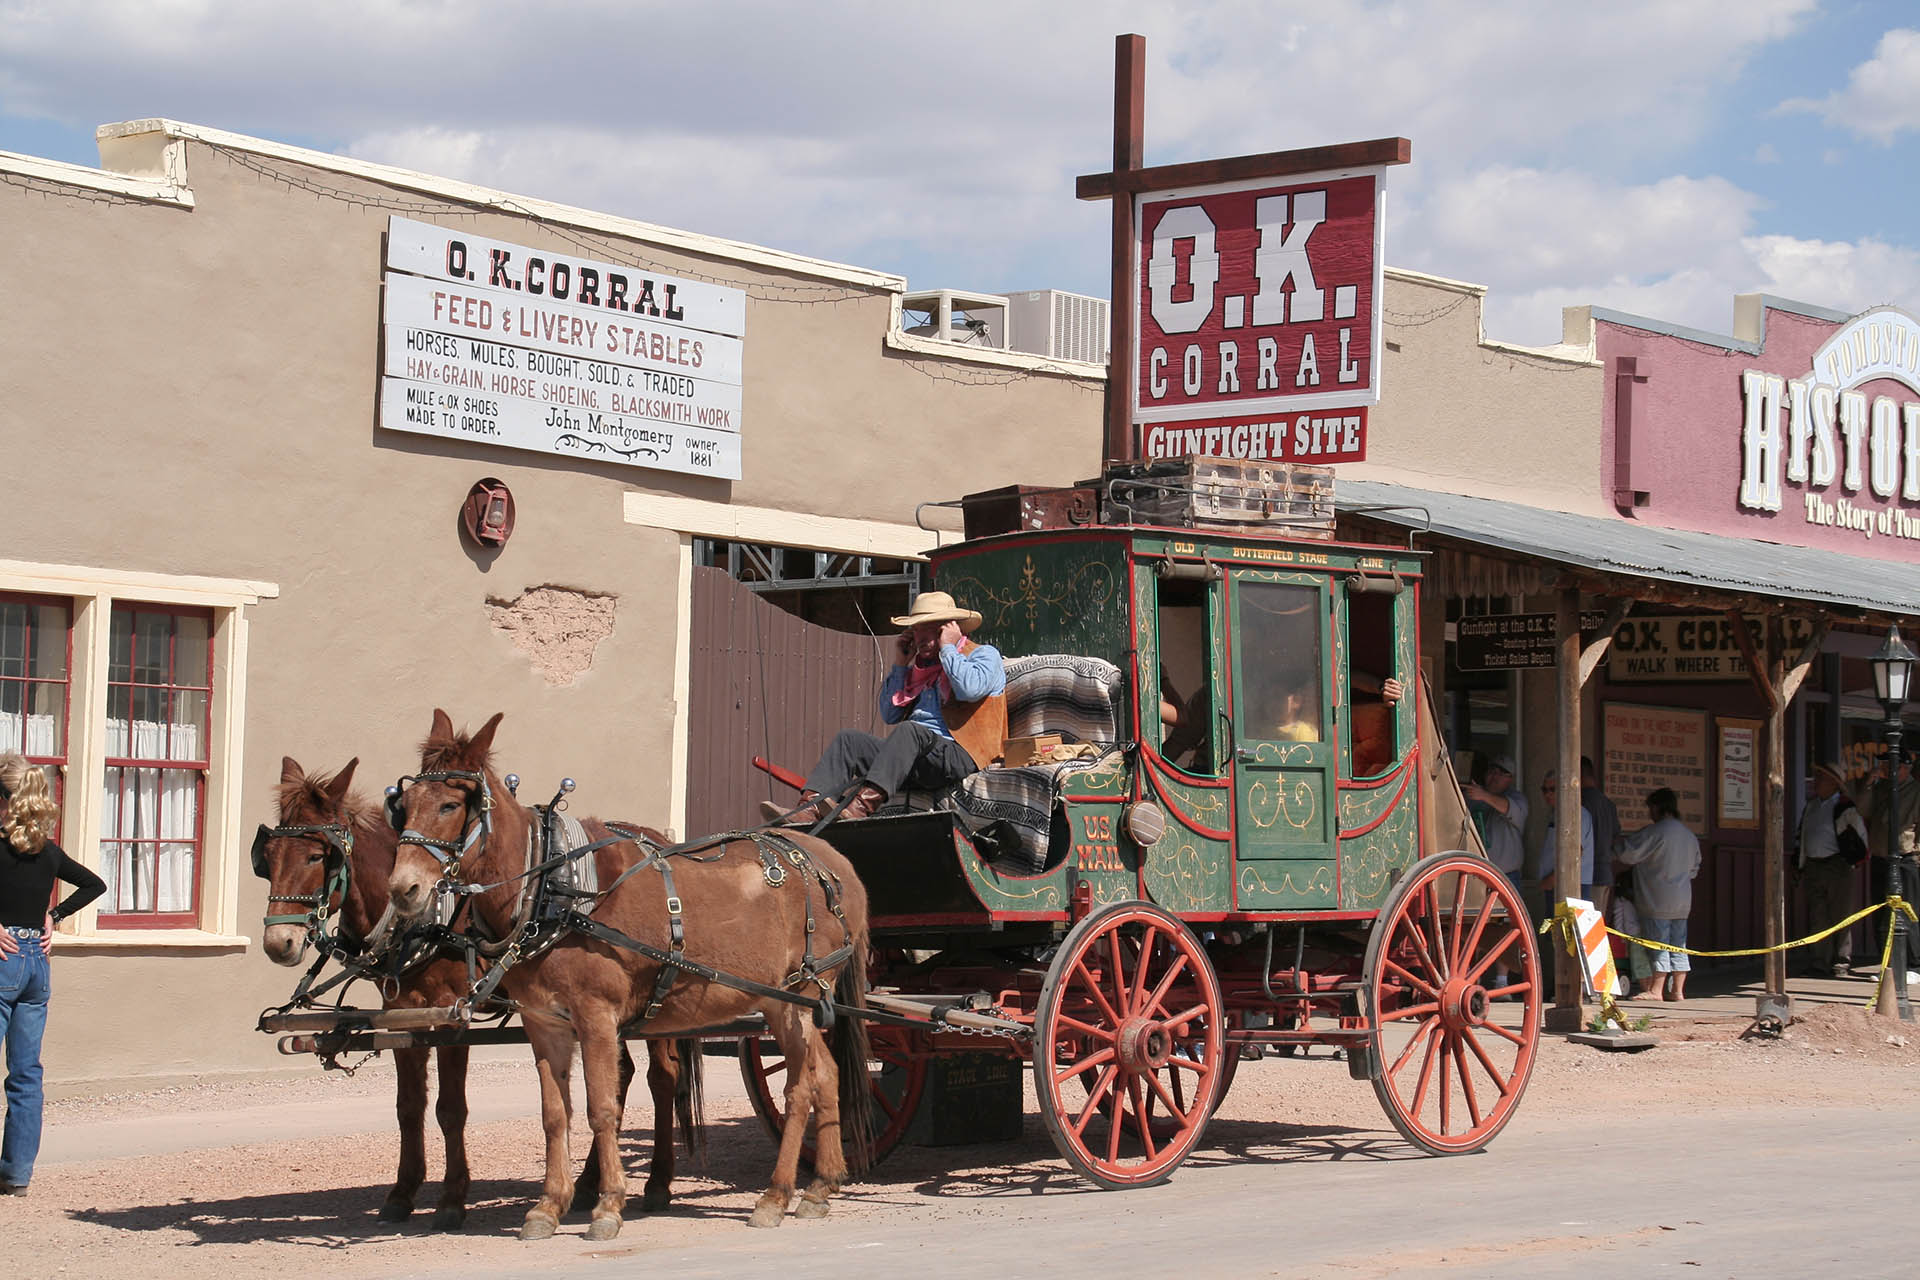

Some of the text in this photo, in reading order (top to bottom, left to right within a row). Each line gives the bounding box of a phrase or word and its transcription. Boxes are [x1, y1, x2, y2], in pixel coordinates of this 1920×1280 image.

[1149, 189, 1358, 334] O.K.
[434, 291, 704, 368] FEED & LIVERY STABLES
[1149, 328, 1359, 400] CORRAL
[1825, 321, 1920, 388] TOMBSTO
[407, 388, 435, 406] MULE
[447, 394, 459, 410] OX
[464, 397, 498, 417] SHOES
[492, 373, 536, 398] HORSE
[612, 393, 692, 423] BLACKSMITH
[696, 406, 731, 428] WORK
[627, 374, 635, 388] &
[644, 372, 695, 398] TRADED
[407, 406, 436, 426] MADE
[442, 413, 456, 429] TO
[545, 407, 581, 431] John
[588, 413, 673, 453] Montgomery
[1148, 415, 1361, 459] GUNFIGHT SITE
[690, 452, 712, 467] 1881
[1804, 492, 1834, 526] The
[1836, 498, 1876, 539] Story
[1878, 507, 1894, 536] of
[1174, 542, 1384, 568] OLD BUTTERFIELD STAGE LINE
[1461, 620, 1497, 637] Gunfight
[1511, 619, 1525, 632] the
[1628, 657, 1665, 672] WALK
[1675, 657, 1720, 672] WHERE
[1076, 845, 1125, 871] MAIL
